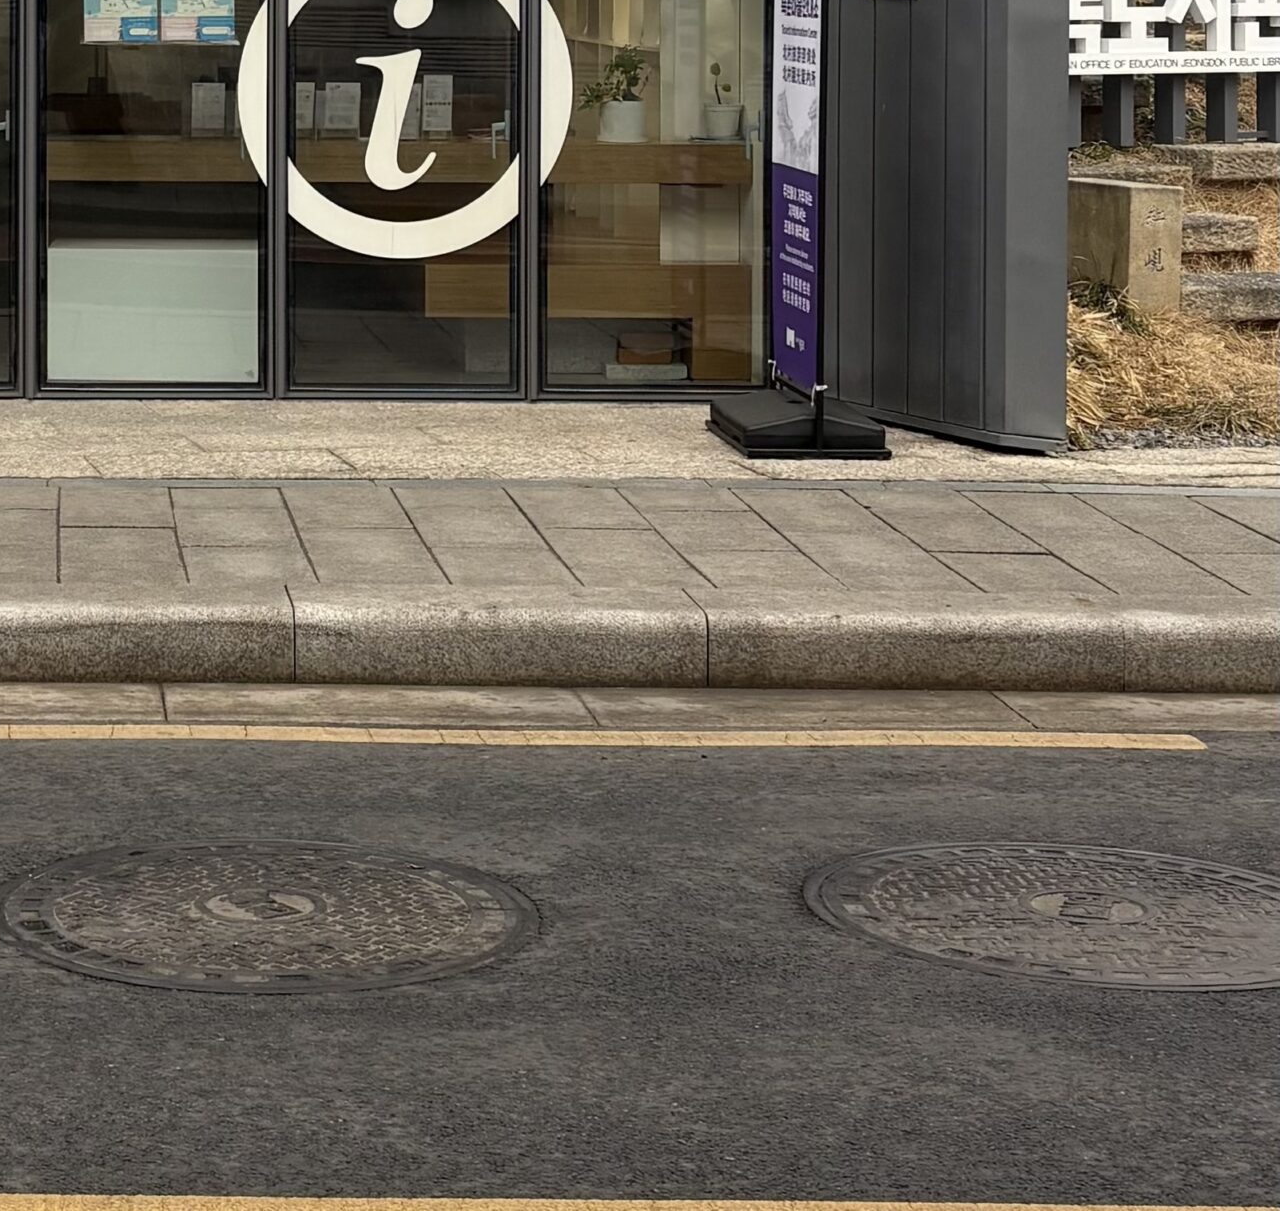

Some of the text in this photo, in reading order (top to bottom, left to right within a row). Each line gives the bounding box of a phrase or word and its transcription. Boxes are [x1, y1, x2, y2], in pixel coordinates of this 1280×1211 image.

[1080, 59, 1111, 70] OFFICE
[1114, 59, 1127, 69] OF
[1129, 58, 1179, 69] EDUCATION
[1181, 57, 1227, 68] JEONGDOK
[1229, 57, 1260, 67] PUBLIC
